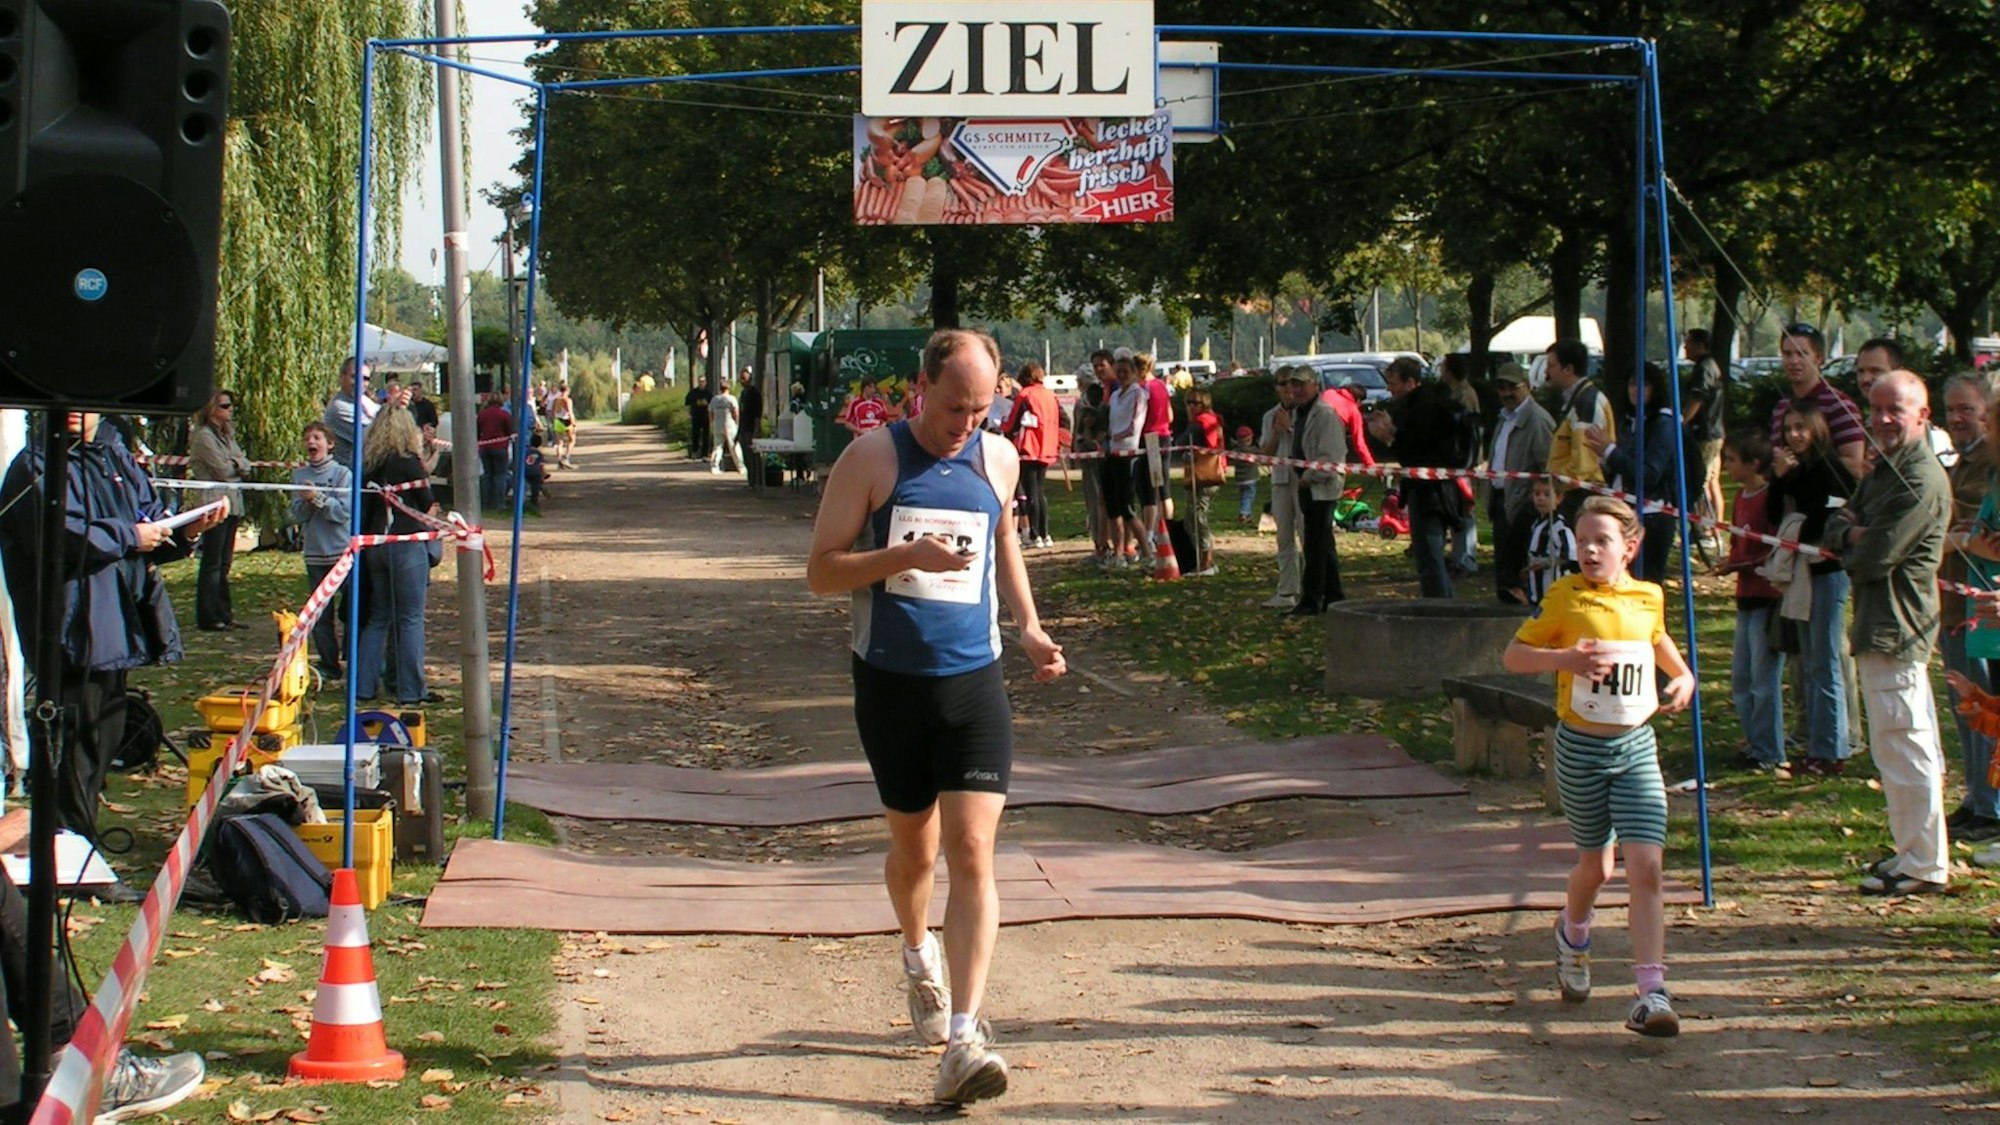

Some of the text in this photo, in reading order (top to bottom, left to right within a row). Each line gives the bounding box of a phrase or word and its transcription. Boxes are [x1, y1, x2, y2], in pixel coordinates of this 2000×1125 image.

[888, 21, 1130, 95] ZIEL
[963, 131, 1051, 144] GS-SCHMITZ
[1096, 114, 1169, 143] lecker
[1074, 159, 1146, 199] frisch
[1100, 190, 1161, 219] HIER
[78, 277, 104, 291] RCF
